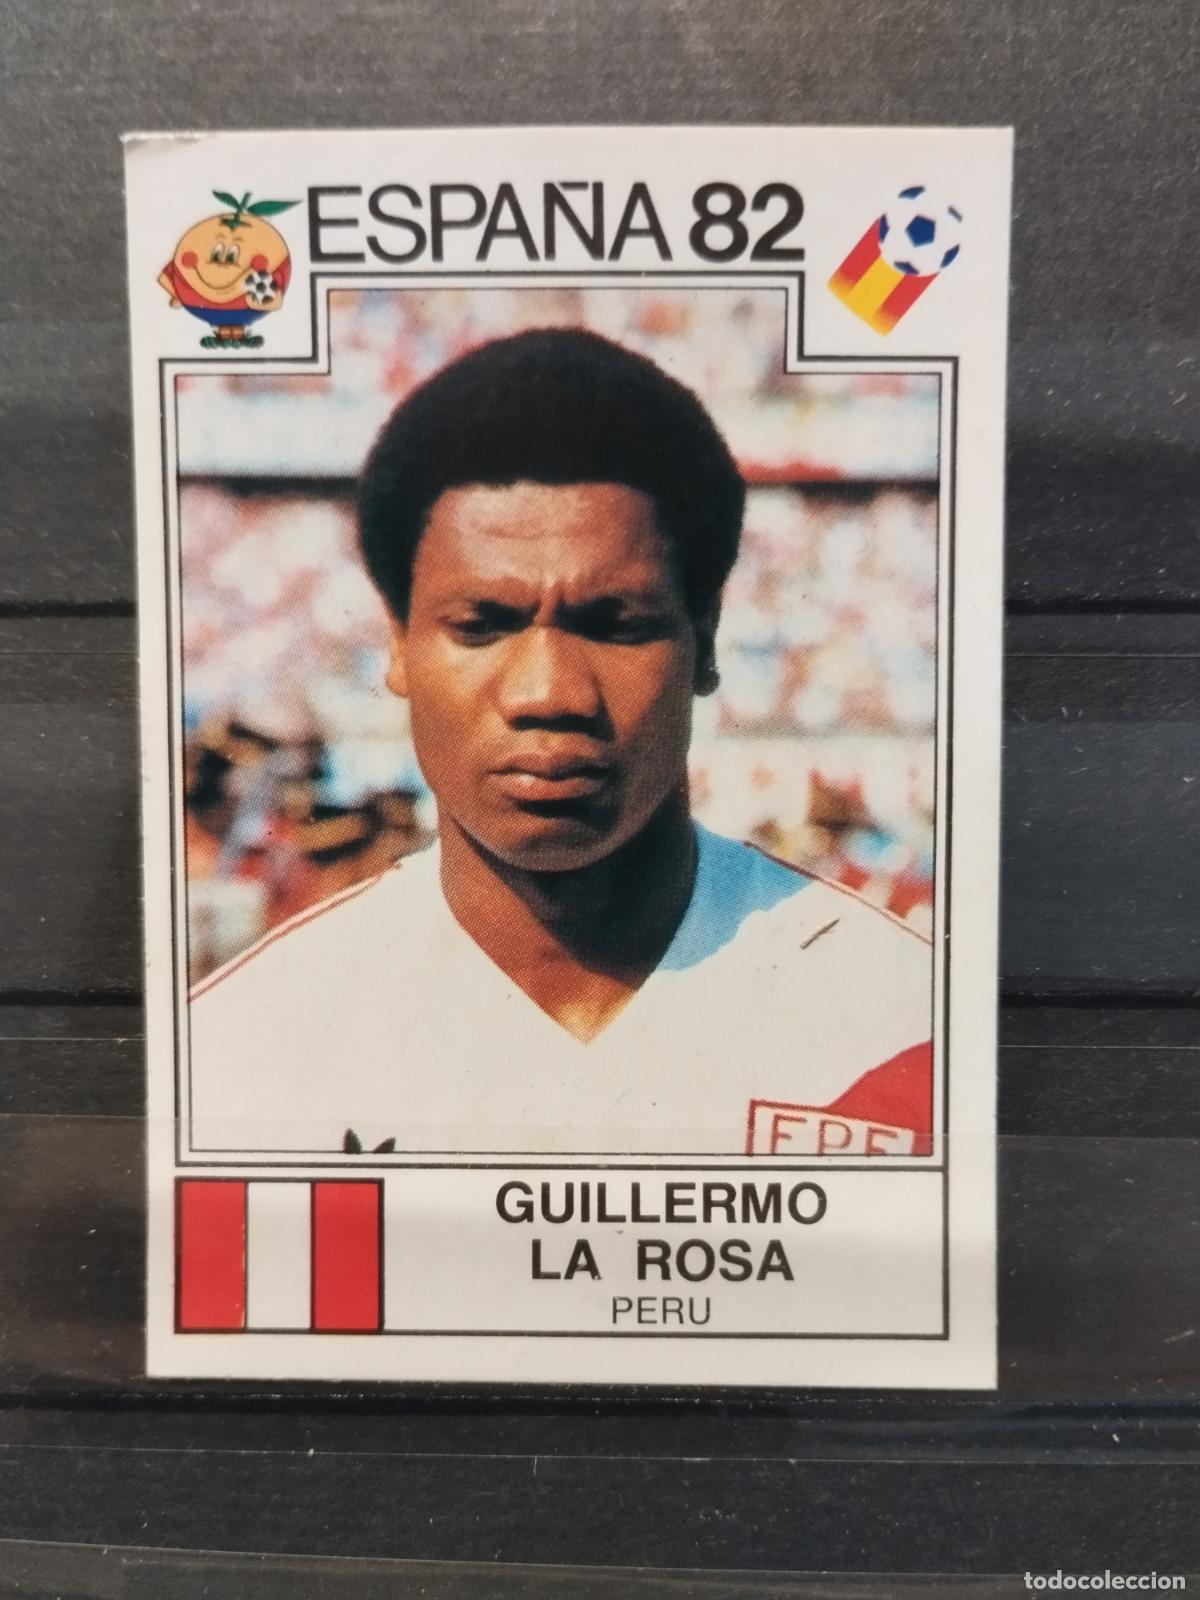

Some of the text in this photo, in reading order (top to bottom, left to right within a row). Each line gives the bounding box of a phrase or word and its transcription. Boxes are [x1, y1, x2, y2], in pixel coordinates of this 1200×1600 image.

[308, 179, 805, 263] ESPAÑA 82
[496, 1181, 828, 1225] GUILLERMO
[531, 1238, 795, 1281] LA ROSA
[611, 1296, 712, 1325] PERU
